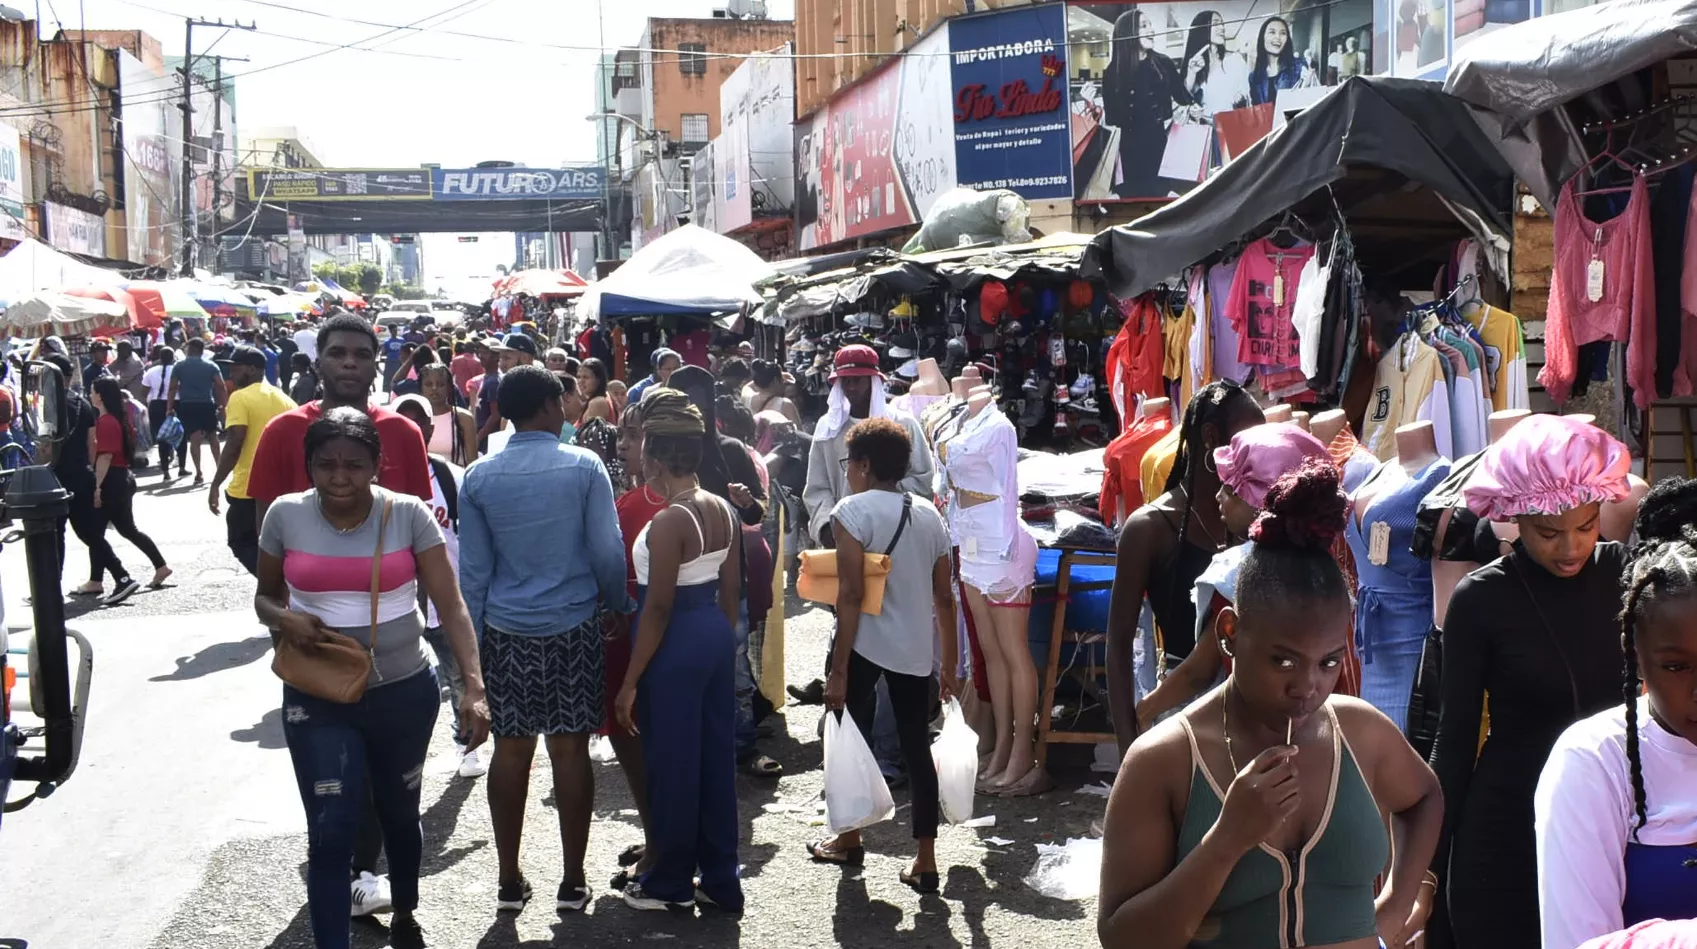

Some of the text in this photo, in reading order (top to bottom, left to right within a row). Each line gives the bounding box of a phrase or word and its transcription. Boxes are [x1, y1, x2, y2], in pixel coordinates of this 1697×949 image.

[955, 38, 1054, 65] IMPORTADORA
[1029, 123, 1066, 132] variedades
[981, 142, 992, 150] por
[993, 141, 1012, 149] mayor
[1018, 137, 1042, 146] detalle
[442, 171, 556, 195] FUTURO
[558, 172, 598, 188] ARS
[1371, 386, 1390, 422] B
